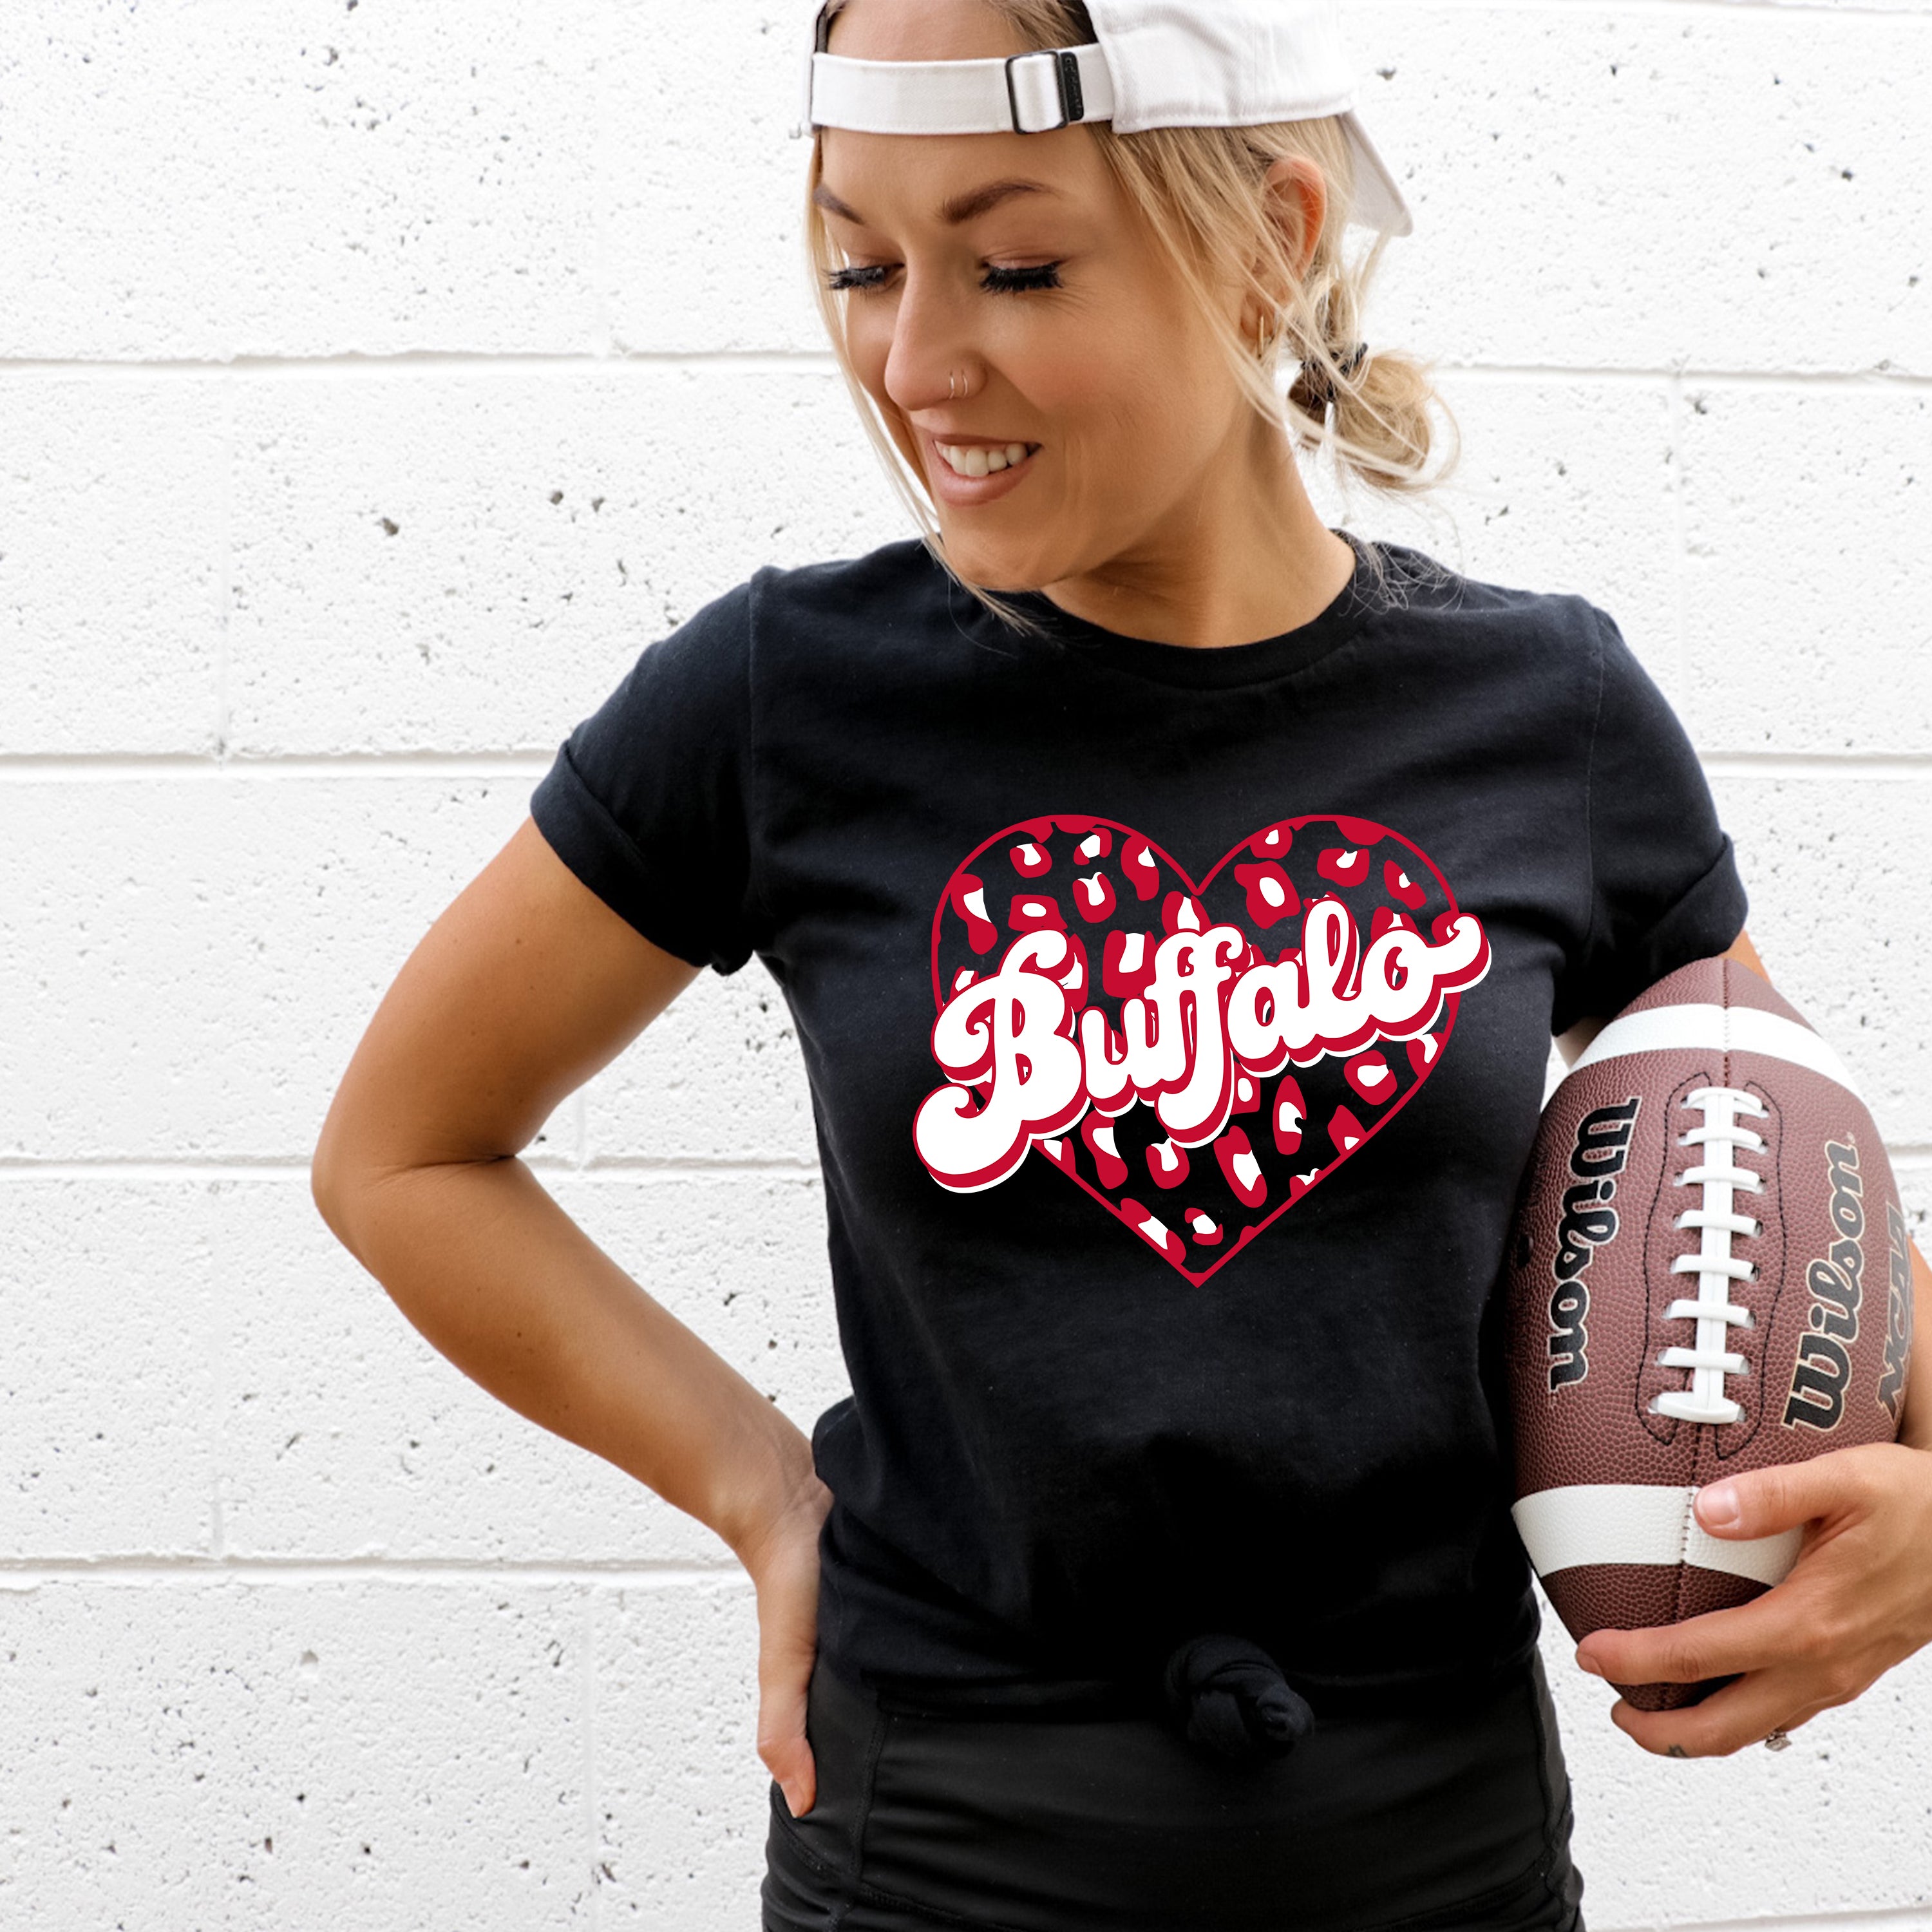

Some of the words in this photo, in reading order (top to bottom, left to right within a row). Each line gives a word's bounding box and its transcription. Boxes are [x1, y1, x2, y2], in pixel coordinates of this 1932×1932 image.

[913, 893, 1492, 1193] Buffalo
[1549, 1096, 1642, 1392] Wilson
[1780, 1141, 1865, 1432] Wilson
